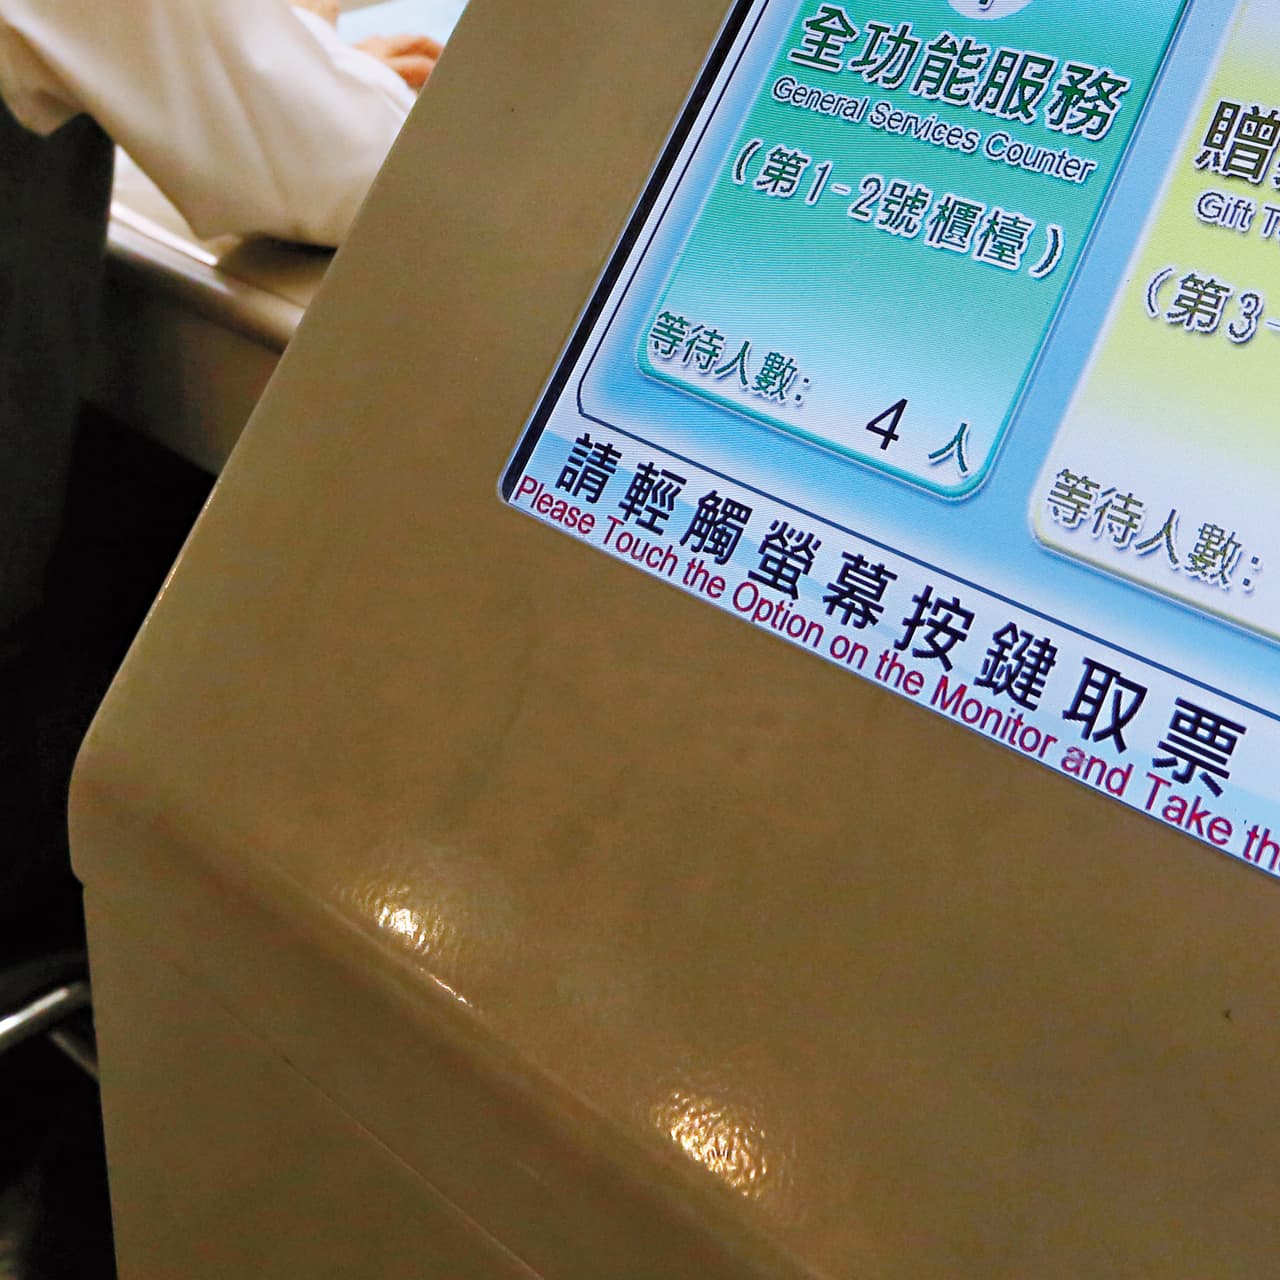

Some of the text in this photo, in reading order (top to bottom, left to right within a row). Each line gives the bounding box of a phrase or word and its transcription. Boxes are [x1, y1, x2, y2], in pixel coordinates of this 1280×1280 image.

[789, 4, 1131, 141] 全功能服務
[773, 75, 1097, 185] General Services Counter
[1195, 189, 1252, 233] Gift
[866, 398, 910, 451] 4
[928, 421, 970, 476] 人
[515, 476, 595, 536] Please
[604, 515, 679, 578] Touch
[682, 557, 727, 599] the
[732, 580, 825, 650] Option
[829, 634, 870, 670] on
[874, 649, 925, 696] the
[930, 674, 1059, 759] Monitor
[1060, 746, 1134, 797] and
[1145, 770, 1234, 846] Take
